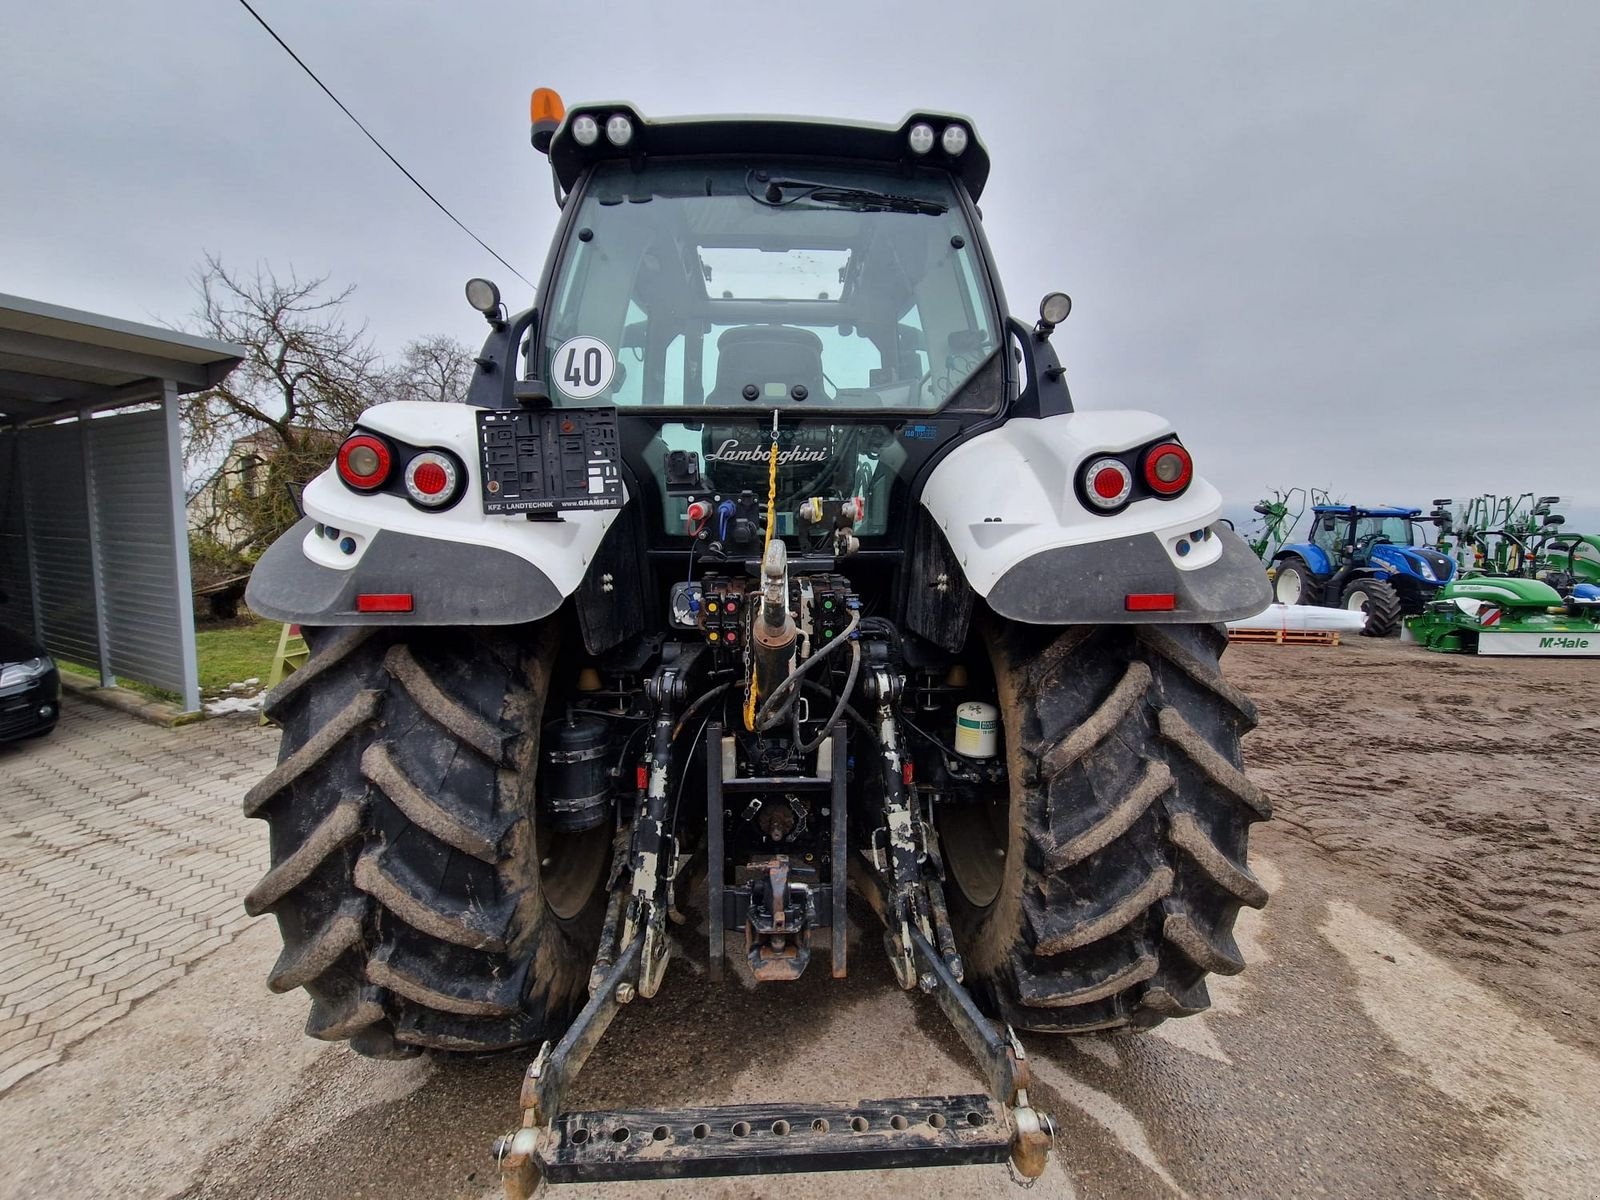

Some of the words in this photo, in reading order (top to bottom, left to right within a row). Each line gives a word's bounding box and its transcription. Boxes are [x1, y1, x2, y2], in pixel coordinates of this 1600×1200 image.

[564, 347, 602, 387] 40
[704, 439, 827, 465] Lamboghini
[506, 501, 554, 510] LANDTECHNIK
